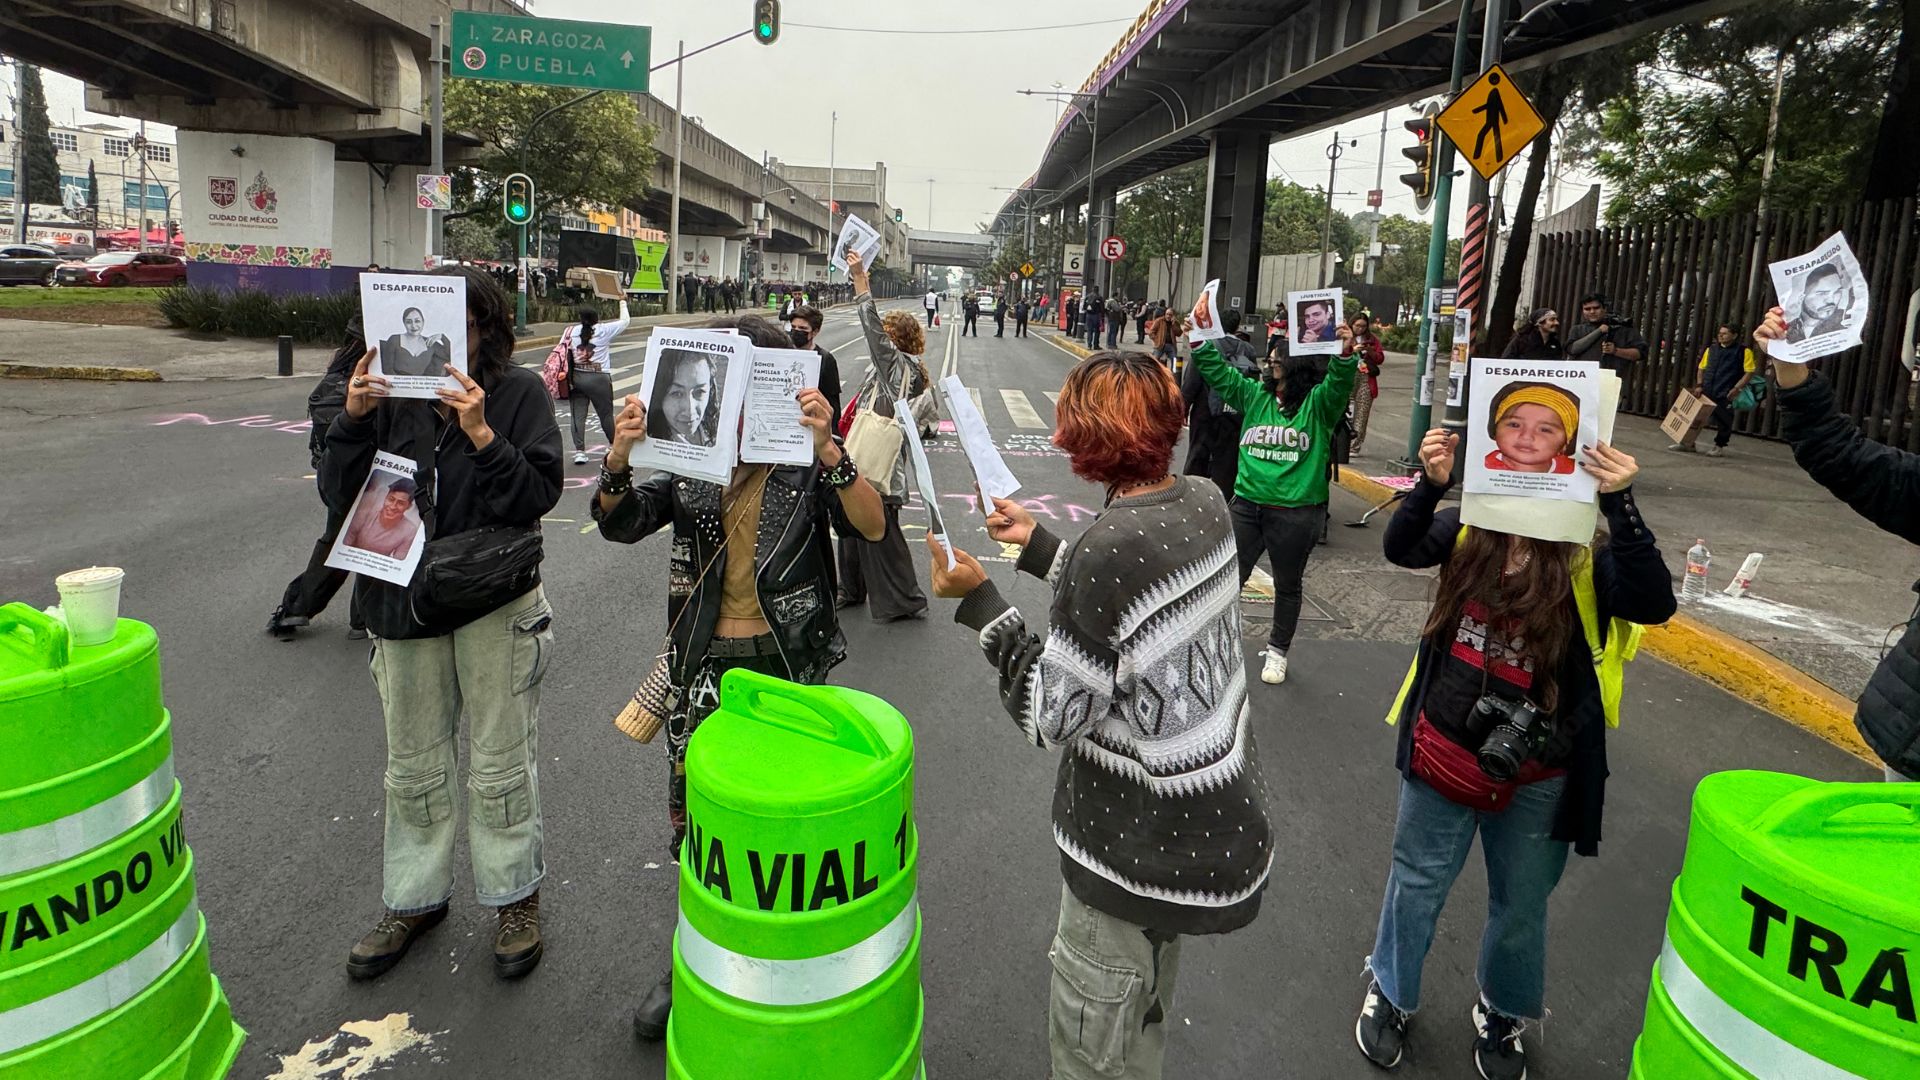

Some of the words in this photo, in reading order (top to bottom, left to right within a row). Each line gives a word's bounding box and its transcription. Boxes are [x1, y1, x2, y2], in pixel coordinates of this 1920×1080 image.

[470, 24, 479, 41] I.
[491, 26, 606, 51] ZARAGOZA
[499, 54, 596, 77] PUEBLA
[208, 214, 236, 222] CIUDAD
[250, 216, 278, 224] MÉXICO
[35, 230, 48, 238] DEL
[50, 231, 73, 240] TACO
[1070, 257, 1080, 270] 6
[1784, 244, 1841, 276] DESAPARECIDO
[372, 283, 455, 294] DESAPARECIDA
[659, 338, 735, 354] DESAPARECIDA
[1485, 367, 1587, 379] DESAPARECIDA
[1239, 425, 1310, 451] MEXICO
[746, 840, 878, 913] VIAL
[1740, 884, 1919, 1024] TRÁ
